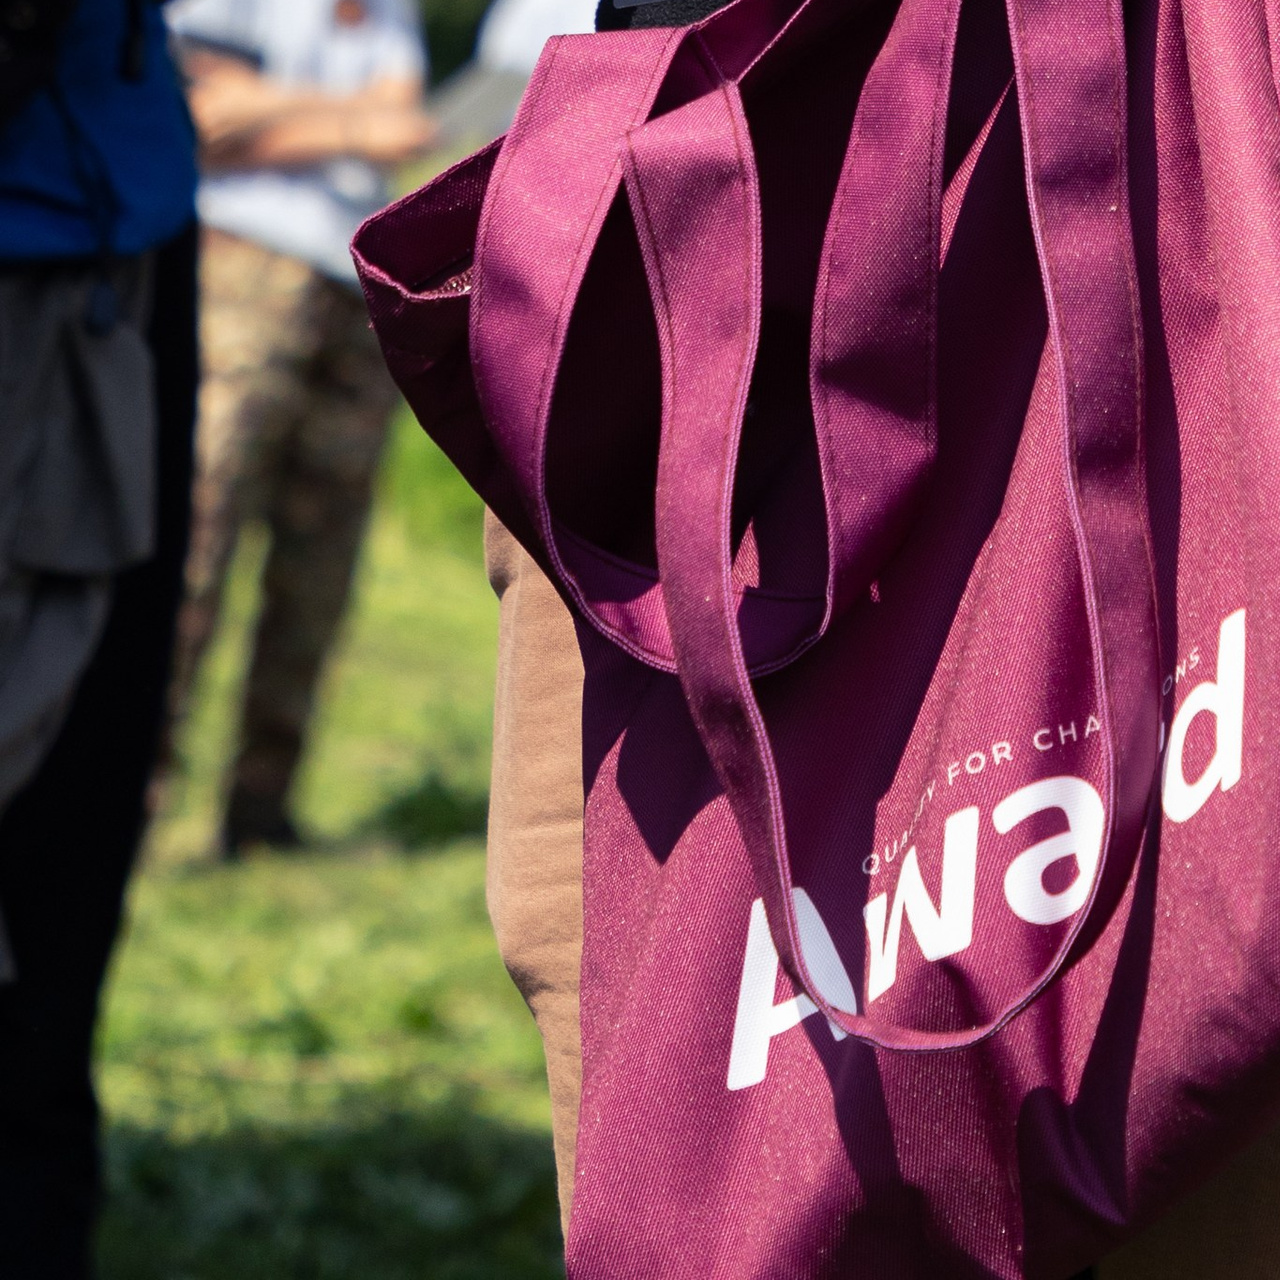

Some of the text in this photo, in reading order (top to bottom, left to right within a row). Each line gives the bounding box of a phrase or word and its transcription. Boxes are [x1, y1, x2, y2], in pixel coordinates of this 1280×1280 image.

[726, 608, 1246, 1092] Awad
[947, 741, 1013, 787] FOR
[1033, 646, 1201, 751] CHAONS
